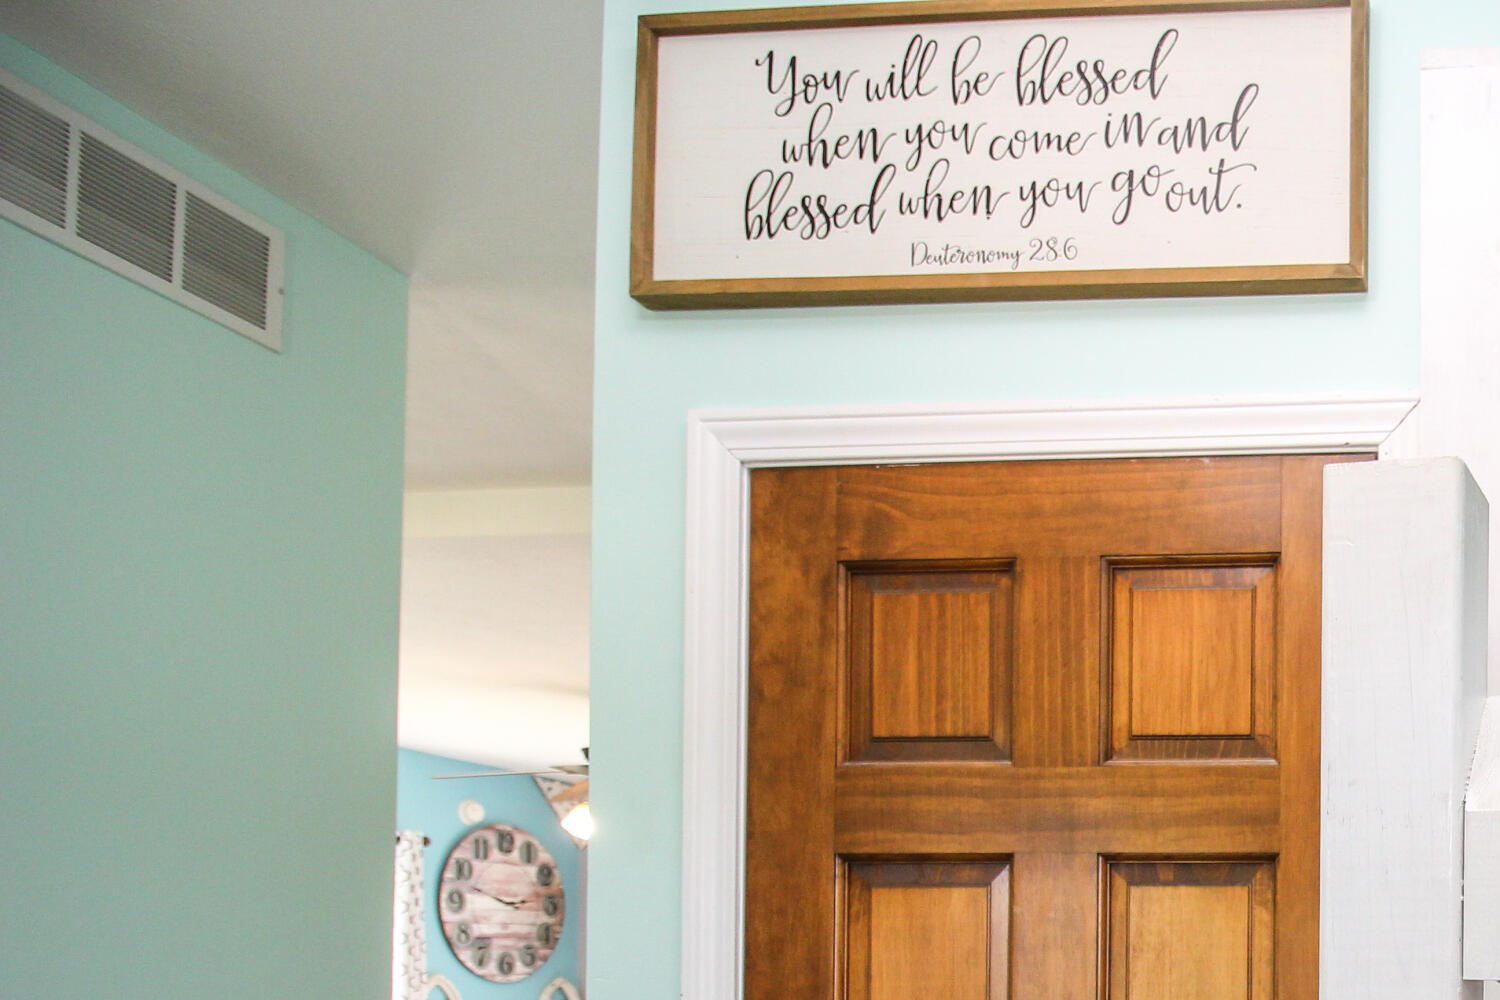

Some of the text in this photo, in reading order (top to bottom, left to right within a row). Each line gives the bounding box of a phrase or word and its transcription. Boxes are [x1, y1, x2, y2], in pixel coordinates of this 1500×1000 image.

[755, 28, 1179, 117] You will be blessed
[782, 82, 1260, 172] when you come in and
[744, 157, 1258, 240] blessed when you go out.
[910, 241, 1023, 271] Deuteronomy
